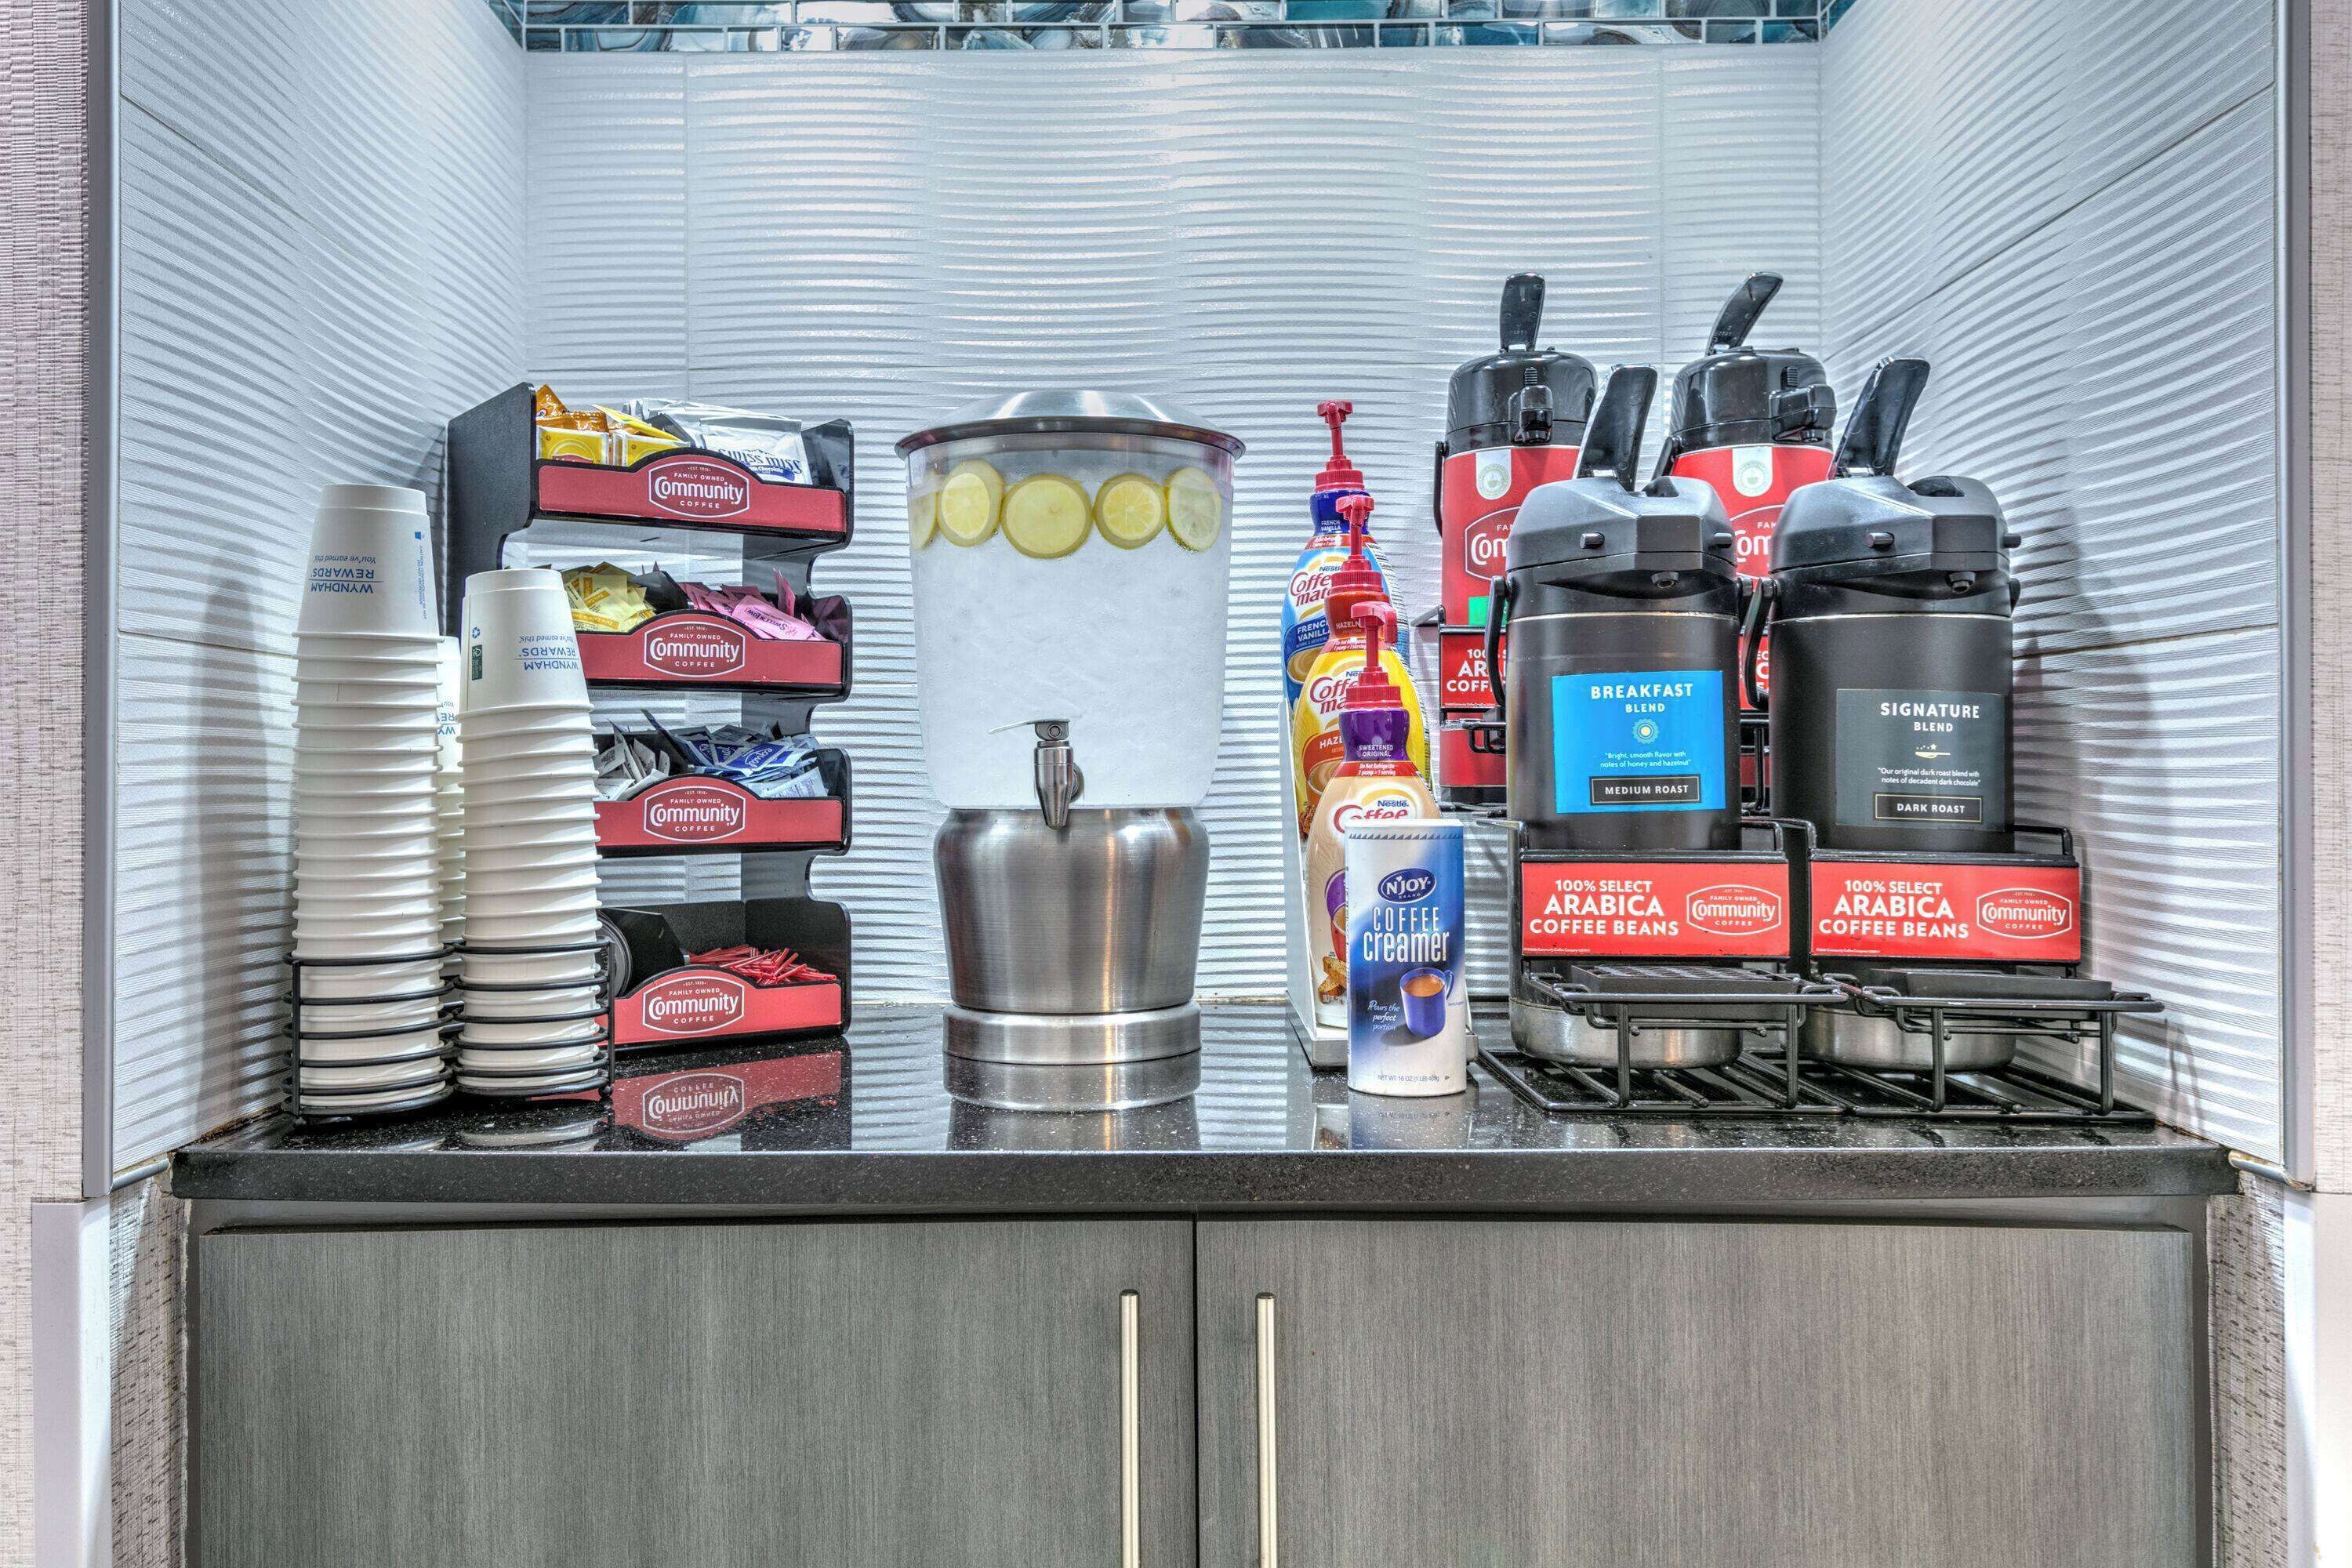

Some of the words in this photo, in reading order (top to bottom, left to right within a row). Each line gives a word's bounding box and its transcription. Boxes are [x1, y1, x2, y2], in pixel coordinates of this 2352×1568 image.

[655, 476, 744, 505] Community
[680, 500, 720, 509] COFFEE
[312, 568, 375, 579] REWARDS
[311, 583, 374, 594] WYNDHAM
[1290, 572, 1332, 597] Coffe
[1297, 620, 1327, 633] FRENC
[1336, 620, 1360, 629] HAZELN
[521, 647, 576, 657] REWARDS
[650, 637, 740, 662] Community
[524, 660, 579, 671] WYNDHAM
[1446, 680, 1493, 692] COFF
[1591, 683, 1693, 699] BREAKFAST
[1625, 703, 1665, 713] BLEND
[1880, 702, 1980, 719] SIGNATURE
[1914, 722, 1954, 732] BLEND
[1627, 760, 1648, 768] honey
[1894, 768, 1919, 776] original
[1605, 786, 1651, 795] MEDIUM
[1655, 785, 1689, 793] ROAST
[650, 803, 740, 827] Community
[1896, 803, 1928, 812] DARK
[1932, 804, 1965, 814] ROAST
[1555, 879, 1596, 892] 100%
[1599, 880, 1653, 893] SELECT
[1845, 880, 1886, 893] 100%
[1889, 880, 1943, 895] SELECT
[1544, 893, 1665, 916] ARABICA
[1692, 899, 1776, 922] Community
[1833, 894, 1955, 919] ARABICA
[1373, 906, 1439, 932] COFFEE
[1982, 902, 2067, 926] Community
[1529, 918, 1606, 935] COFFEE
[1613, 920, 1679, 936] BEANS
[1818, 919, 1896, 936] COFFEE
[1903, 921, 1969, 938] BEANS
[1363, 931, 1450, 963] creamer
[648, 993, 739, 1020] Community
[1367, 1000, 1388, 1011] Pours
[1388, 1003, 1400, 1011] the
[1372, 1012, 1397, 1023] perfect
